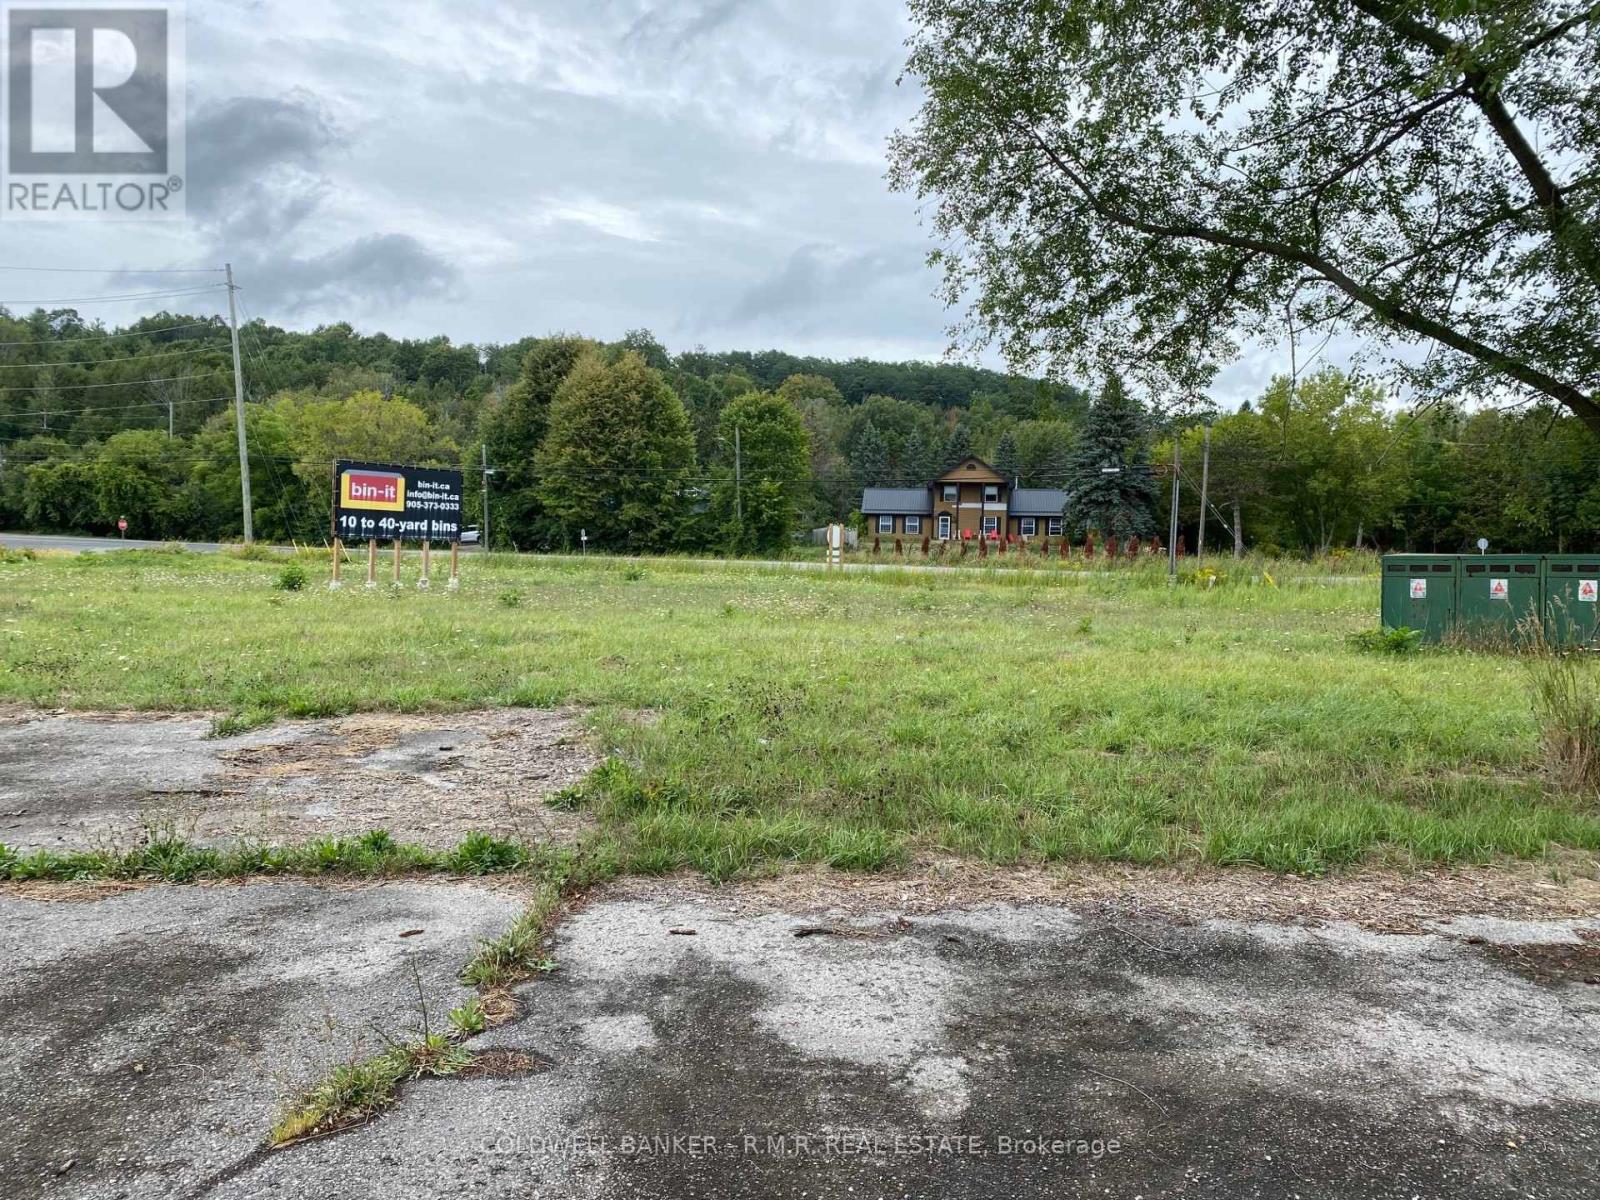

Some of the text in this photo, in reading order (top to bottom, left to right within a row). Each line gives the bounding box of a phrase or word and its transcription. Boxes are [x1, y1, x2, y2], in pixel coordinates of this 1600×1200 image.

[351, 482, 396, 499] bin-it
[417, 480, 450, 490] bin-it.ca
[406, 490, 460, 501] info@bin-it.ca
[406, 500, 460, 511] 905-373-0333
[340, 515, 458, 532] 10 to 40-yard bins
